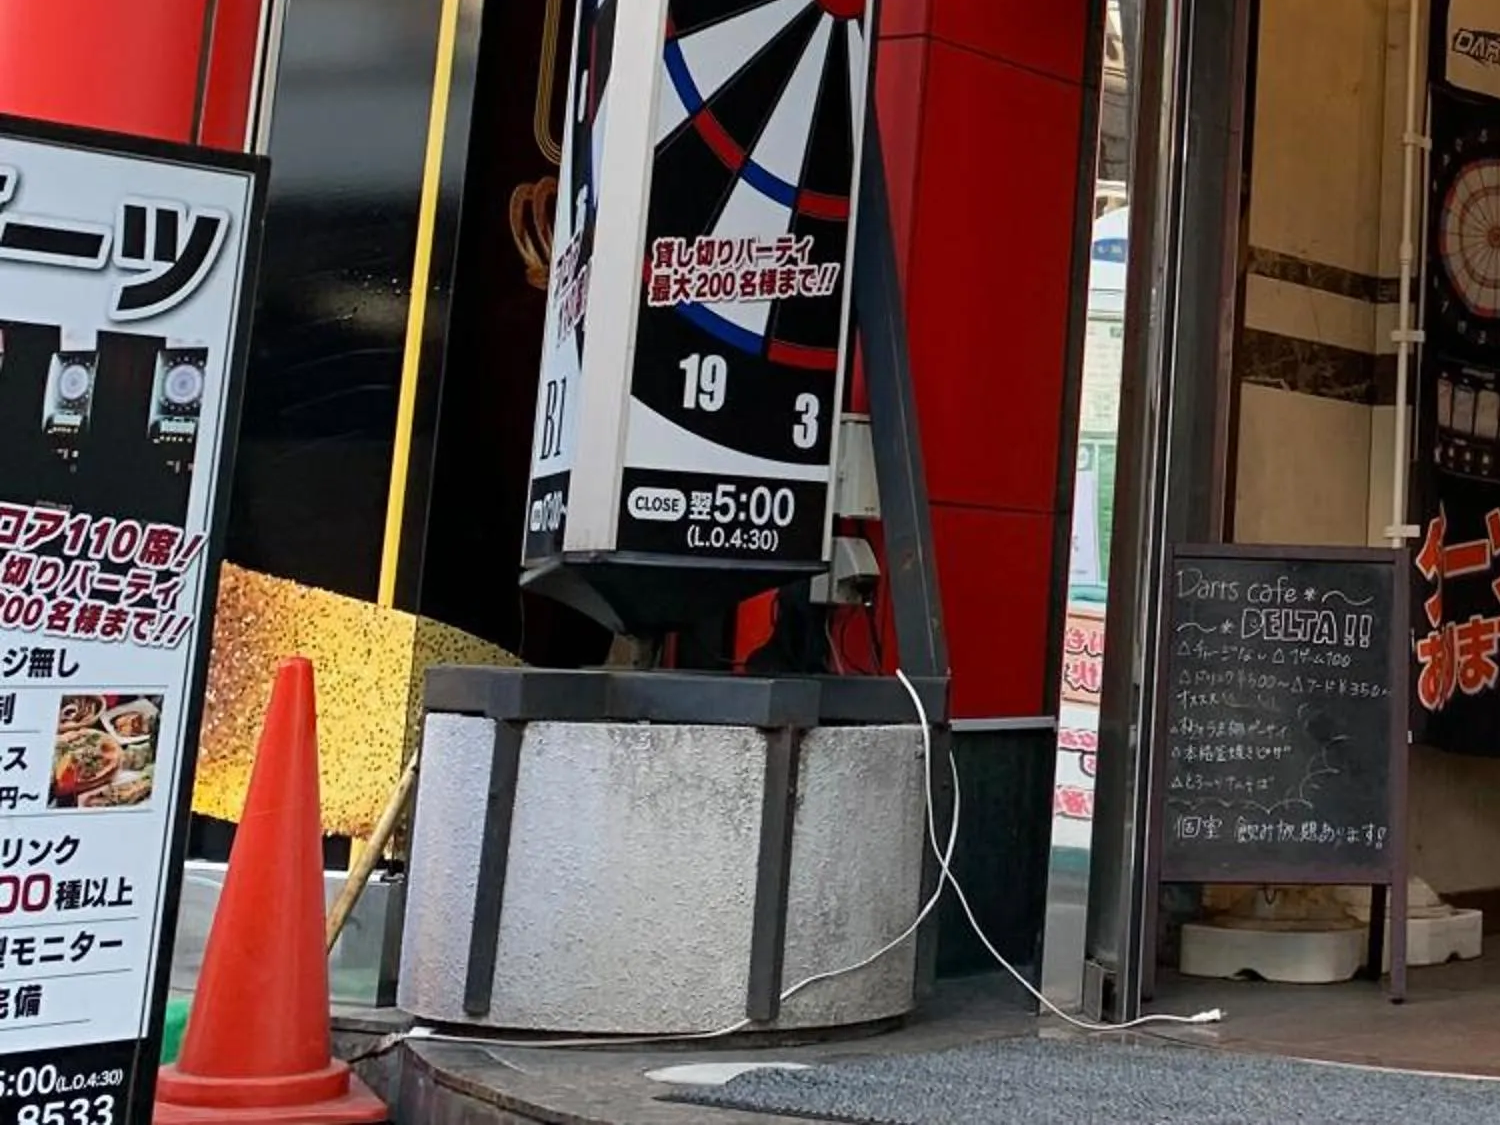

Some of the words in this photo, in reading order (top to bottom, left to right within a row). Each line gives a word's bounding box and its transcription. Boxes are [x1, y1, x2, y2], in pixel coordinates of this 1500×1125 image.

[0, 175, 222, 313] ーツ
[654, 236, 813, 270] 貸し切りパーティ
[679, 353, 728, 412] 19
[792, 392, 820, 449] 3
[635, 495, 680, 513] CLOSE
[1177, 568, 1239, 601] Darts
[1247, 576, 1297, 604] cafe
[0, 593, 191, 644] 00名様まで!!
